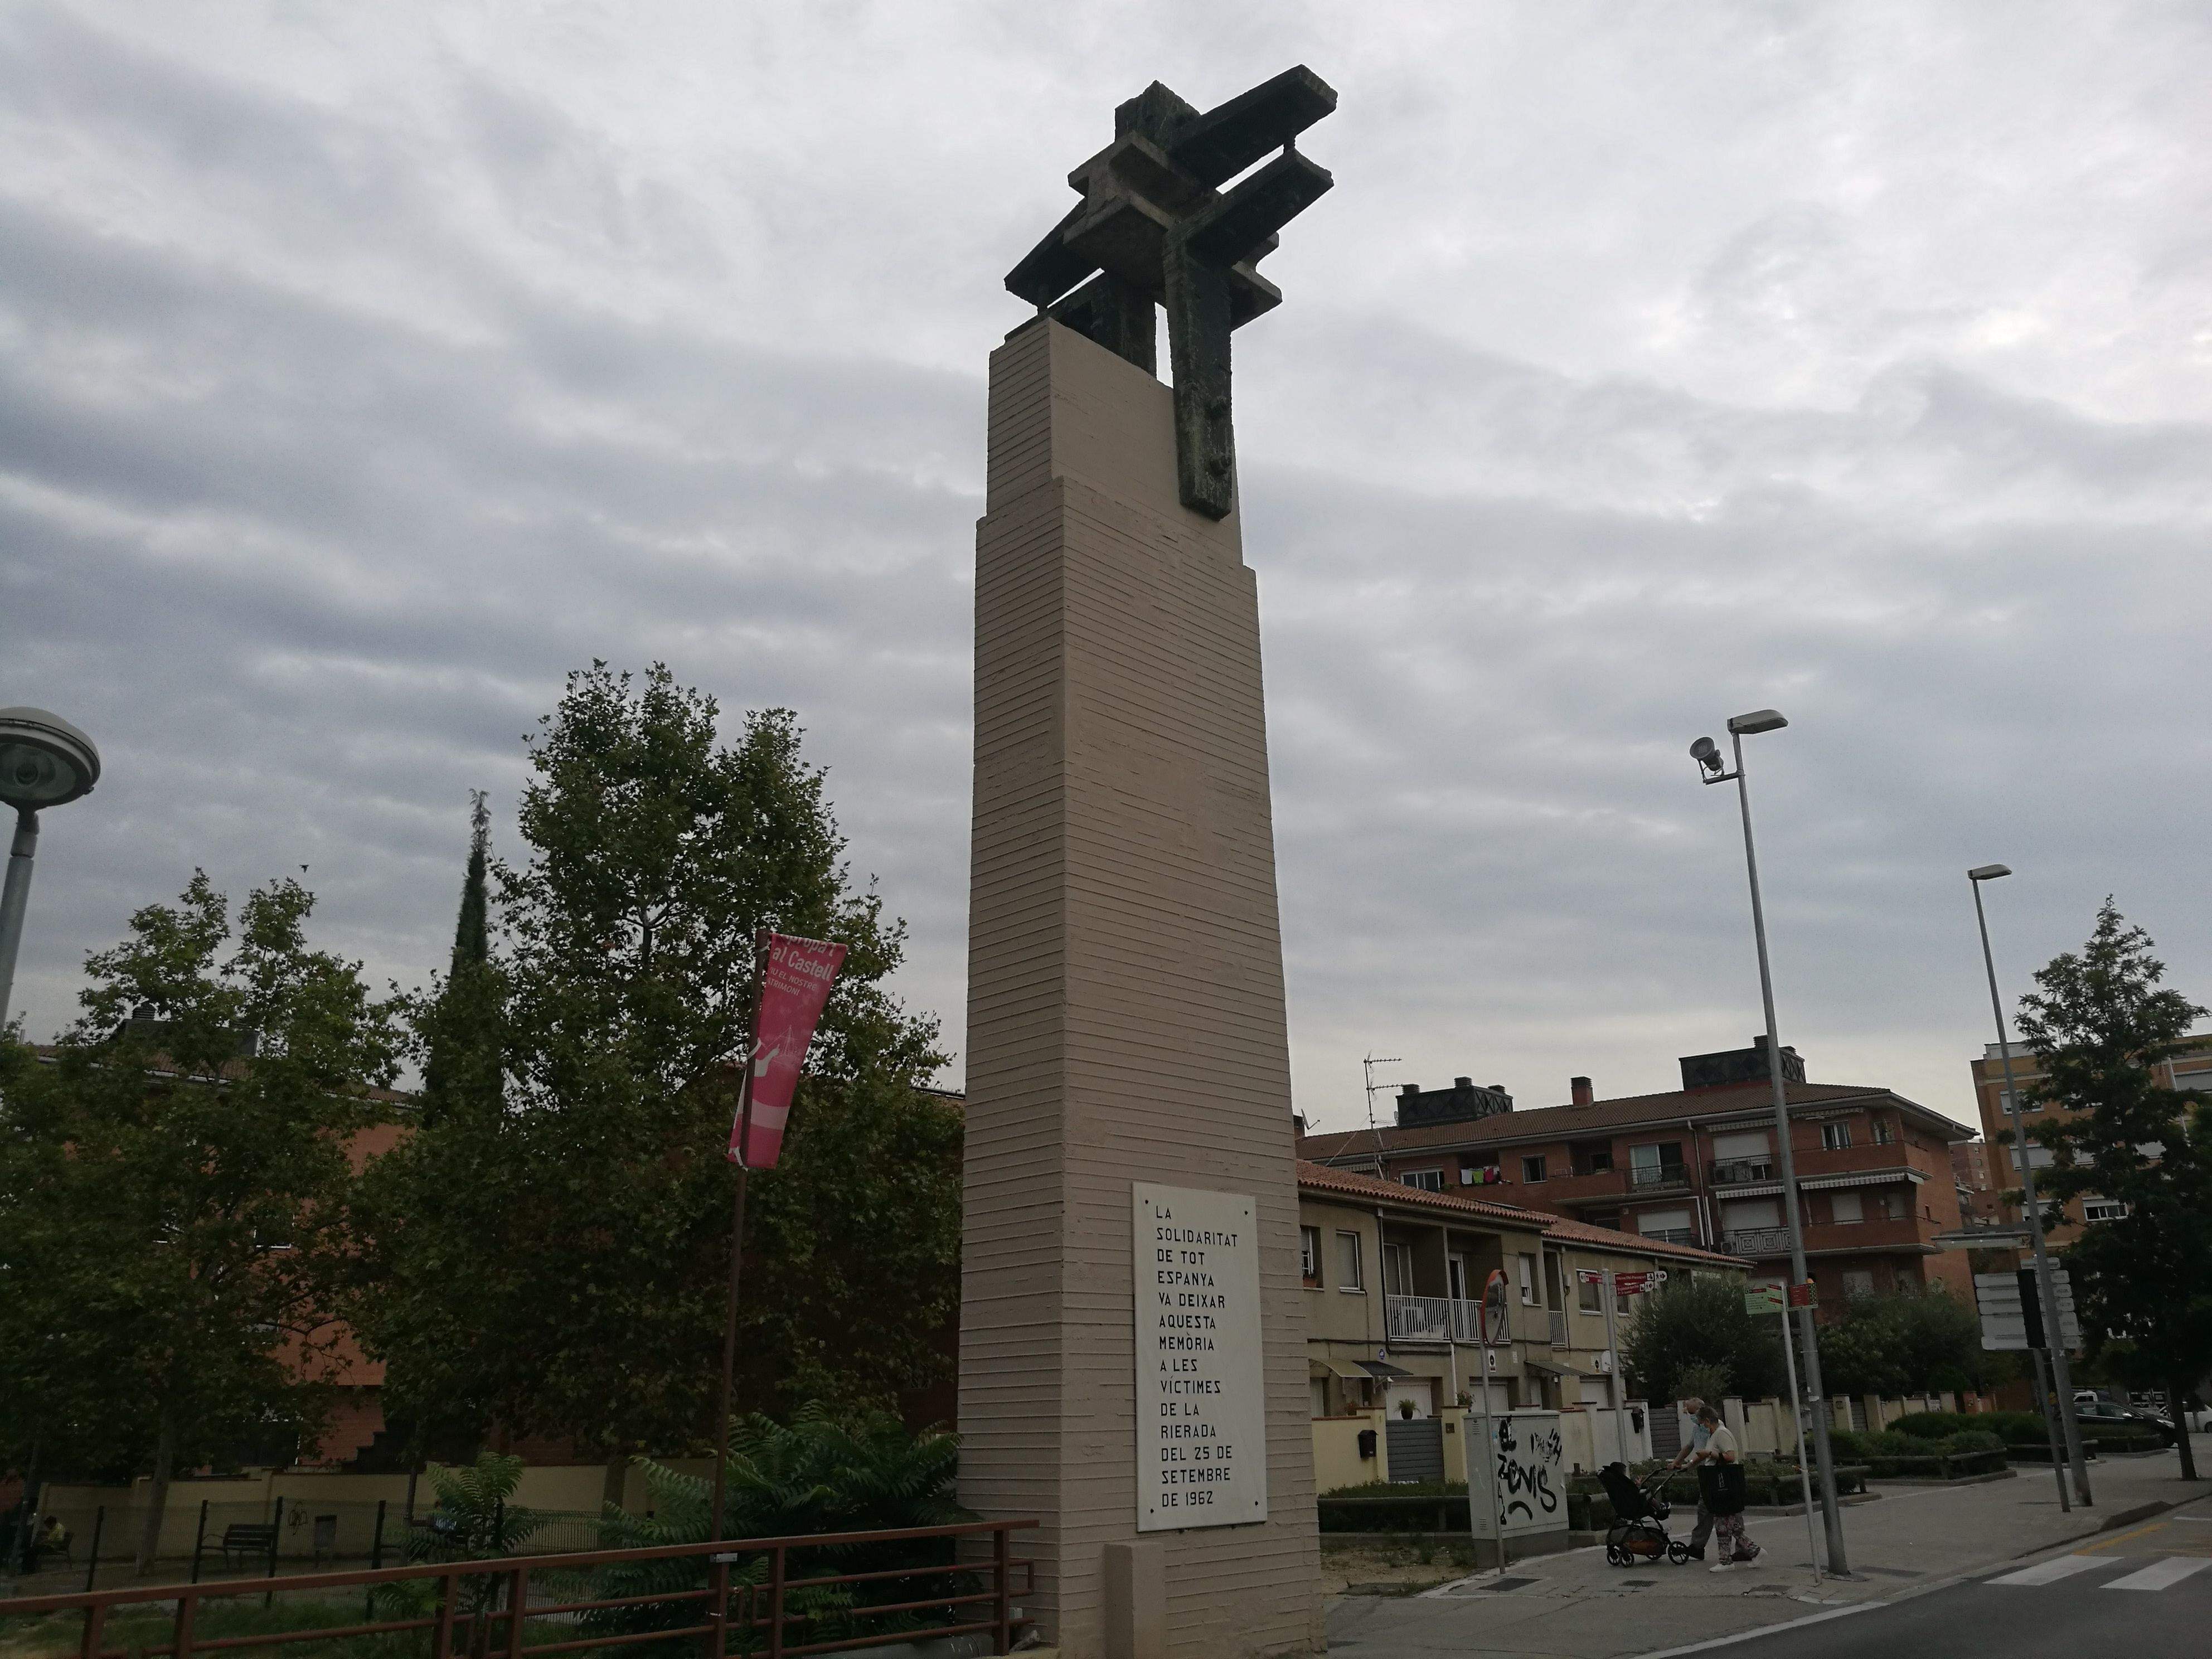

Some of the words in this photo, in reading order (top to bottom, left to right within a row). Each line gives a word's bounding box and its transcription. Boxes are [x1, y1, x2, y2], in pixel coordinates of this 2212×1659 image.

[773, 947, 788, 963] al
[788, 950, 835, 981] Castell
[768, 977, 800, 996] ATRIMONI
[779, 971, 787, 980] EL
[788, 976, 817, 991] NOSTRE
[1156, 1205, 1172, 1220] LA
[1157, 1227, 1238, 1248] SOLIDARITAT
[1157, 1248, 1173, 1263] DE
[1180, 1250, 1205, 1265] TOT
[1157, 1270, 1215, 1287] ESPANYA
[1158, 1292, 1171, 1306] VA
[1178, 1293, 1225, 1309] DEIXAR
[1158, 1314, 1216, 1330] AQUESTA
[1159, 1331, 1214, 1351] MEMÒRIA
[1160, 1359, 1167, 1372] A
[1173, 1358, 1197, 1372] LES
[1160, 1375, 1221, 1394] VÍCTIMES
[1161, 1402, 1177, 1417] DE
[1185, 1402, 1200, 1417] LA
[1161, 1424, 1216, 1439] RIERADA
[1161, 1447, 1187, 1462] DEL
[1194, 1446, 1210, 1461] 25
[1217, 1445, 1233, 1459] DE
[1161, 1467, 1231, 1485] SETEMBRE
[1162, 1492, 1178, 1508] DE
[1185, 1490, 1213, 1506] 1962
